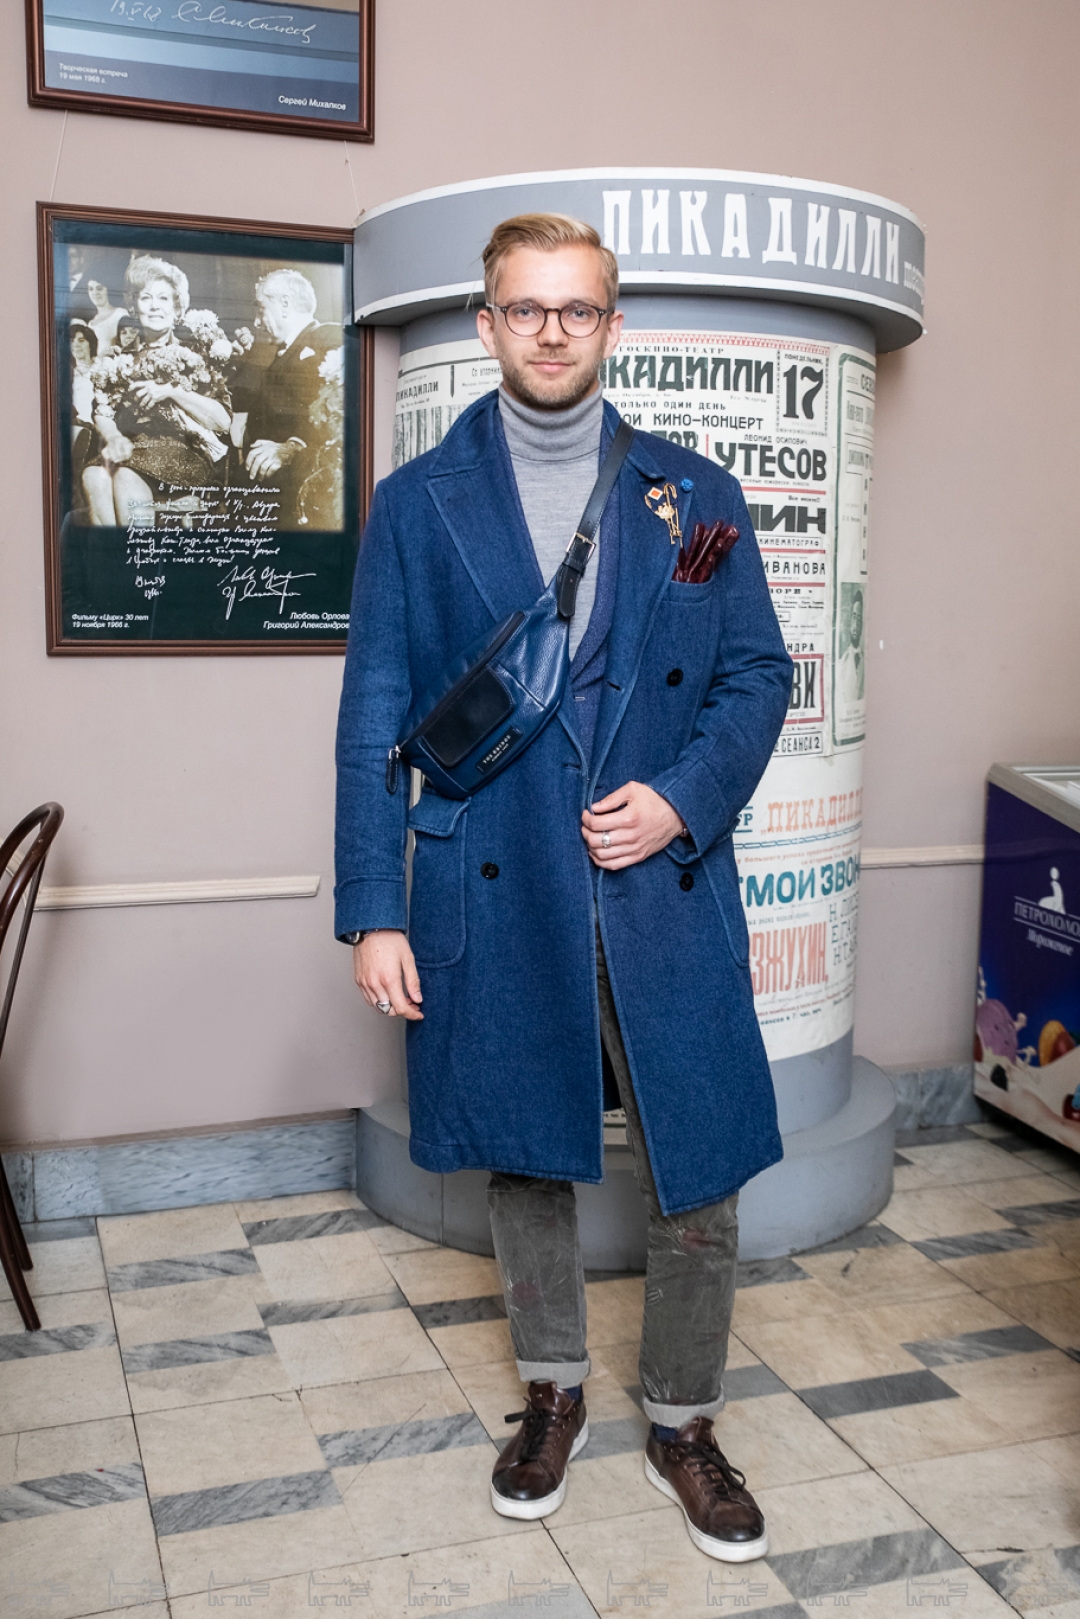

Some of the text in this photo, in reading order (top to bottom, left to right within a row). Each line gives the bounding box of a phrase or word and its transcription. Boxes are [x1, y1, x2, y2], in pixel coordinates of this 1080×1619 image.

[58, 62, 128, 78] Творческая встреча
[59, 72, 68, 80] 19
[278, 95, 346, 110] Сергей Михалков
[602, 188, 900, 285] ПИКАДИЛЛИ
[600, 355, 774, 395] КАДИЛЛИ
[782, 364, 824, 420] 17
[664, 401, 692, 410] ОДИН
[698, 402, 726, 410] ДЕНЬ
[653, 414, 764, 430] КИНО-КОНЦЕРТ
[744, 434, 772, 444] ЛЕОНИД
[715, 442, 827, 482] УТЕСОВ
[71, 614, 98, 622] Фильму
[99, 614, 124, 622] «Цирк»
[289, 612, 350, 622] Любовь Орлова
[82, 621, 106, 629] ноября
[263, 620, 350, 630] Григорий Александров
[814, 736, 820, 748] 2
